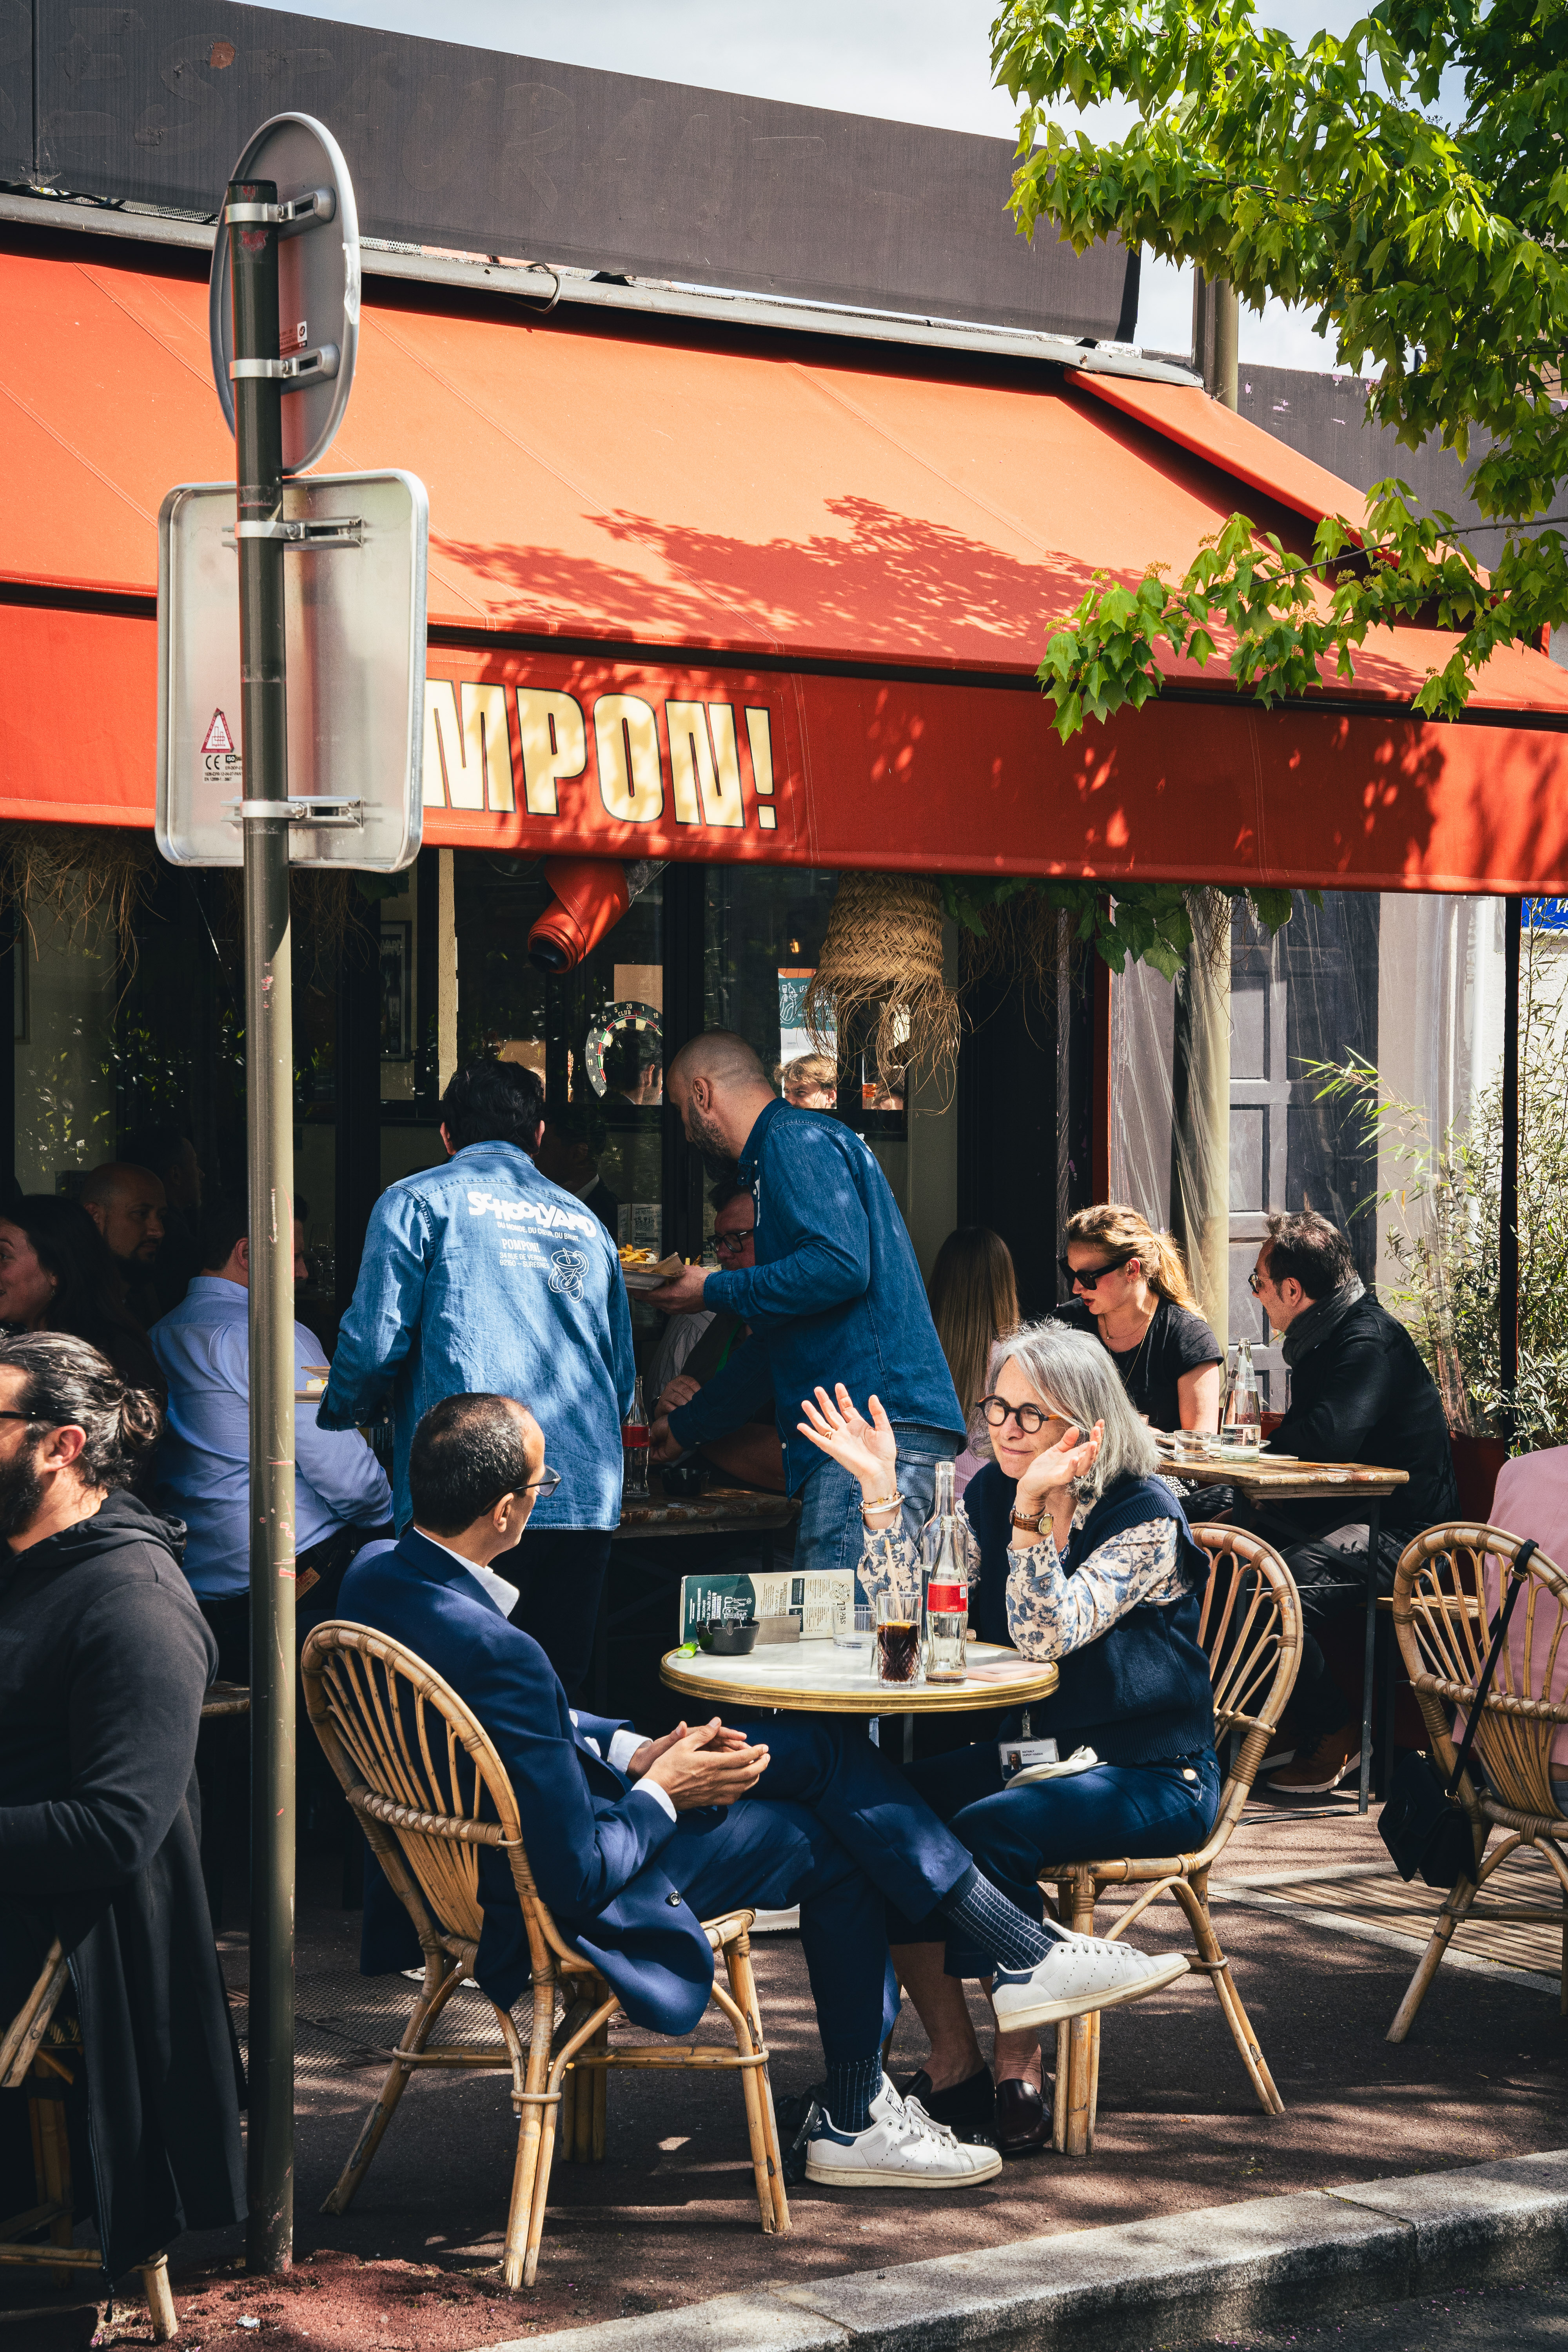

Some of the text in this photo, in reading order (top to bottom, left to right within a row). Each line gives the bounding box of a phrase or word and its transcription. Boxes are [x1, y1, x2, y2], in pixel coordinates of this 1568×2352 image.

[506, 1223, 527, 1233] MONDE.
[564, 1232, 580, 1243] BRUIT.
[501, 1238, 541, 1253] POMPON!
[523, 1261, 550, 1269] SURESNES
[837, 1601, 846, 1624] TAPAS
